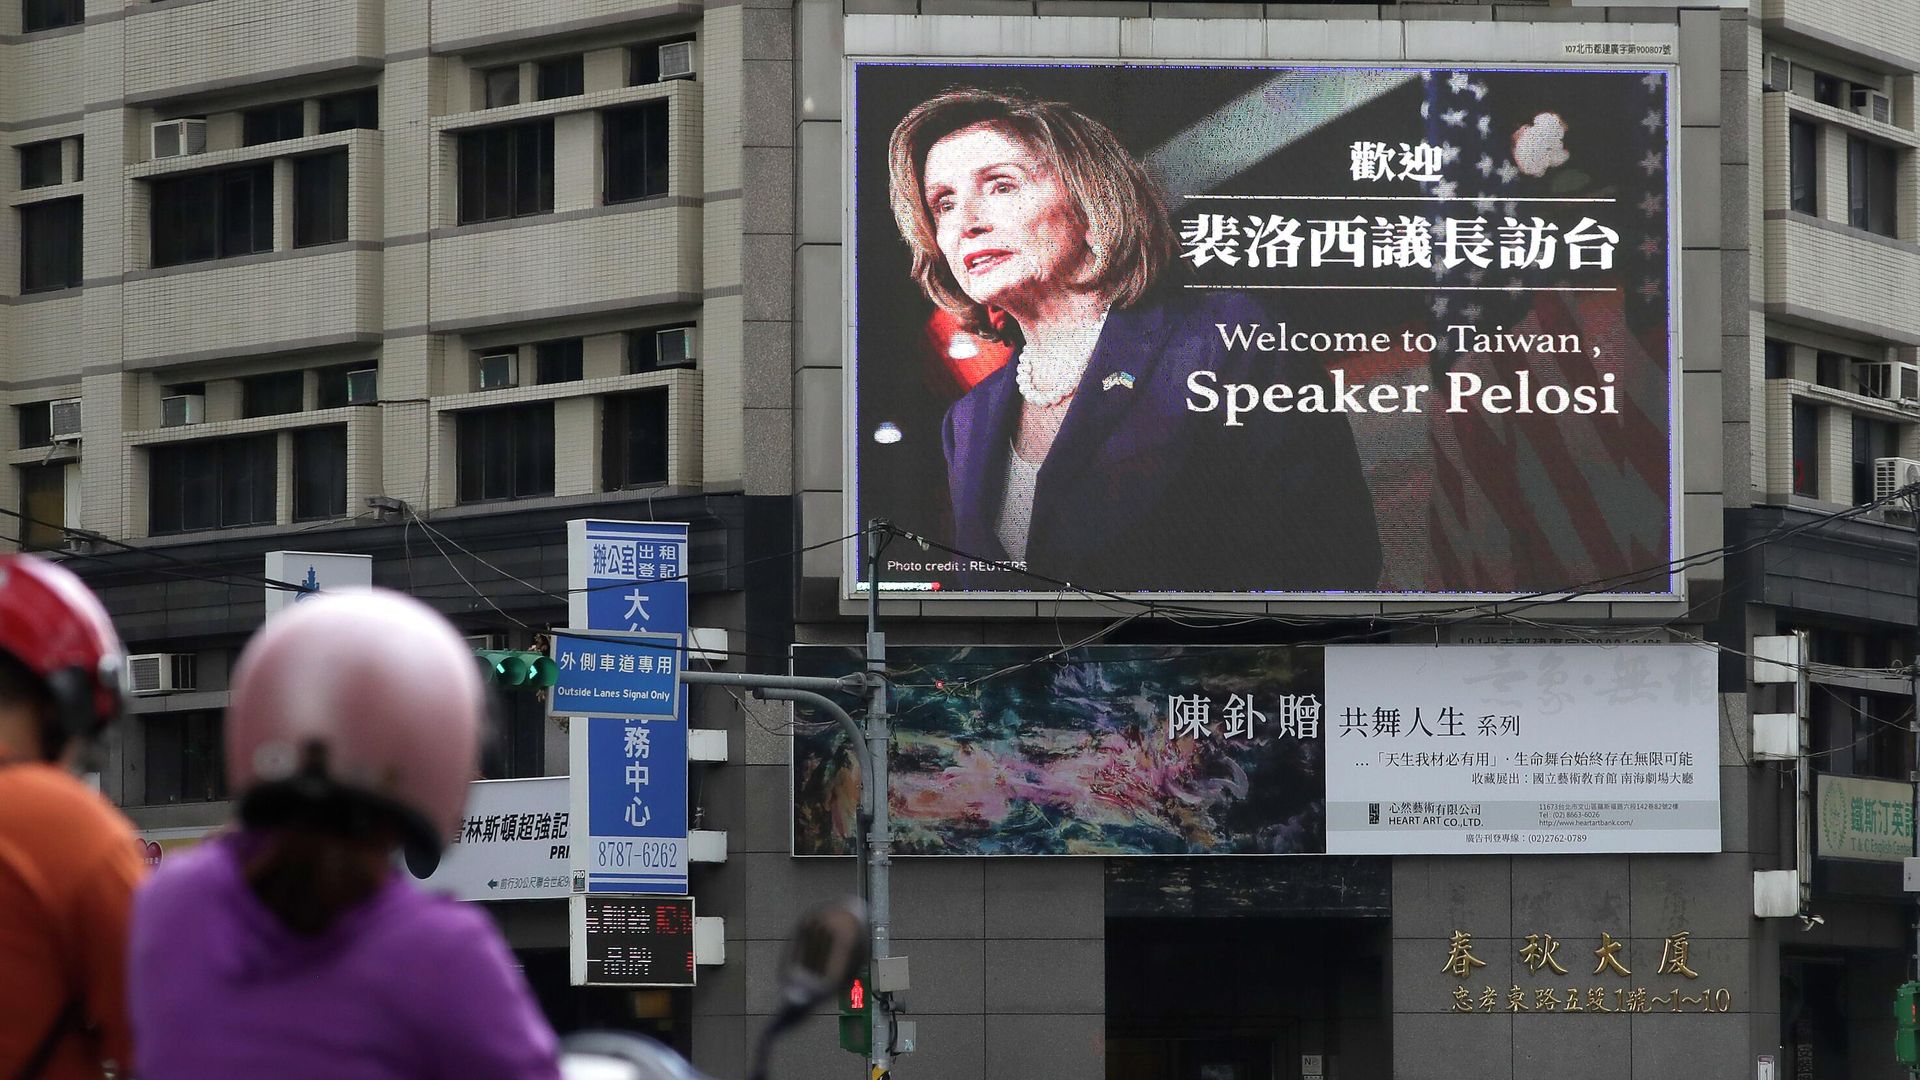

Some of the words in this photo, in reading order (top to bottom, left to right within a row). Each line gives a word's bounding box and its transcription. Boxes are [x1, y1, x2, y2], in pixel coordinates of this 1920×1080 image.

[1350, 142, 1443, 182] 歡迎
[1179, 214, 1619, 270] 裴洛西議長訪台
[1215, 323, 1390, 353] Welcome
[1402, 330, 1437, 353] to
[1186, 369, 1429, 426] Speaker
[1446, 370, 1619, 414] Pelosi
[594, 544, 635, 575] 辦公室
[888, 561, 921, 572] Photo
[925, 561, 959, 572] credit
[970, 561, 1028, 572] REUTERS
[560, 651, 672, 674] 外側車道專用
[558, 686, 592, 697] Outside
[593, 687, 620, 698] Lanes
[622, 689, 649, 701] Signal
[650, 691, 671, 702] Only
[1167, 693, 1322, 740] 陳釙贈
[1338, 707, 1466, 738] 共舞人生
[1477, 715, 1520, 737] 系列
[1389, 801, 1481, 816] 心然藝術有限公司
[1389, 817, 1420, 825] HEART
[1422, 816, 1441, 825] ART
[598, 841, 677, 868] 8787-6262
[1441, 929, 1699, 977] 春秋大廈
